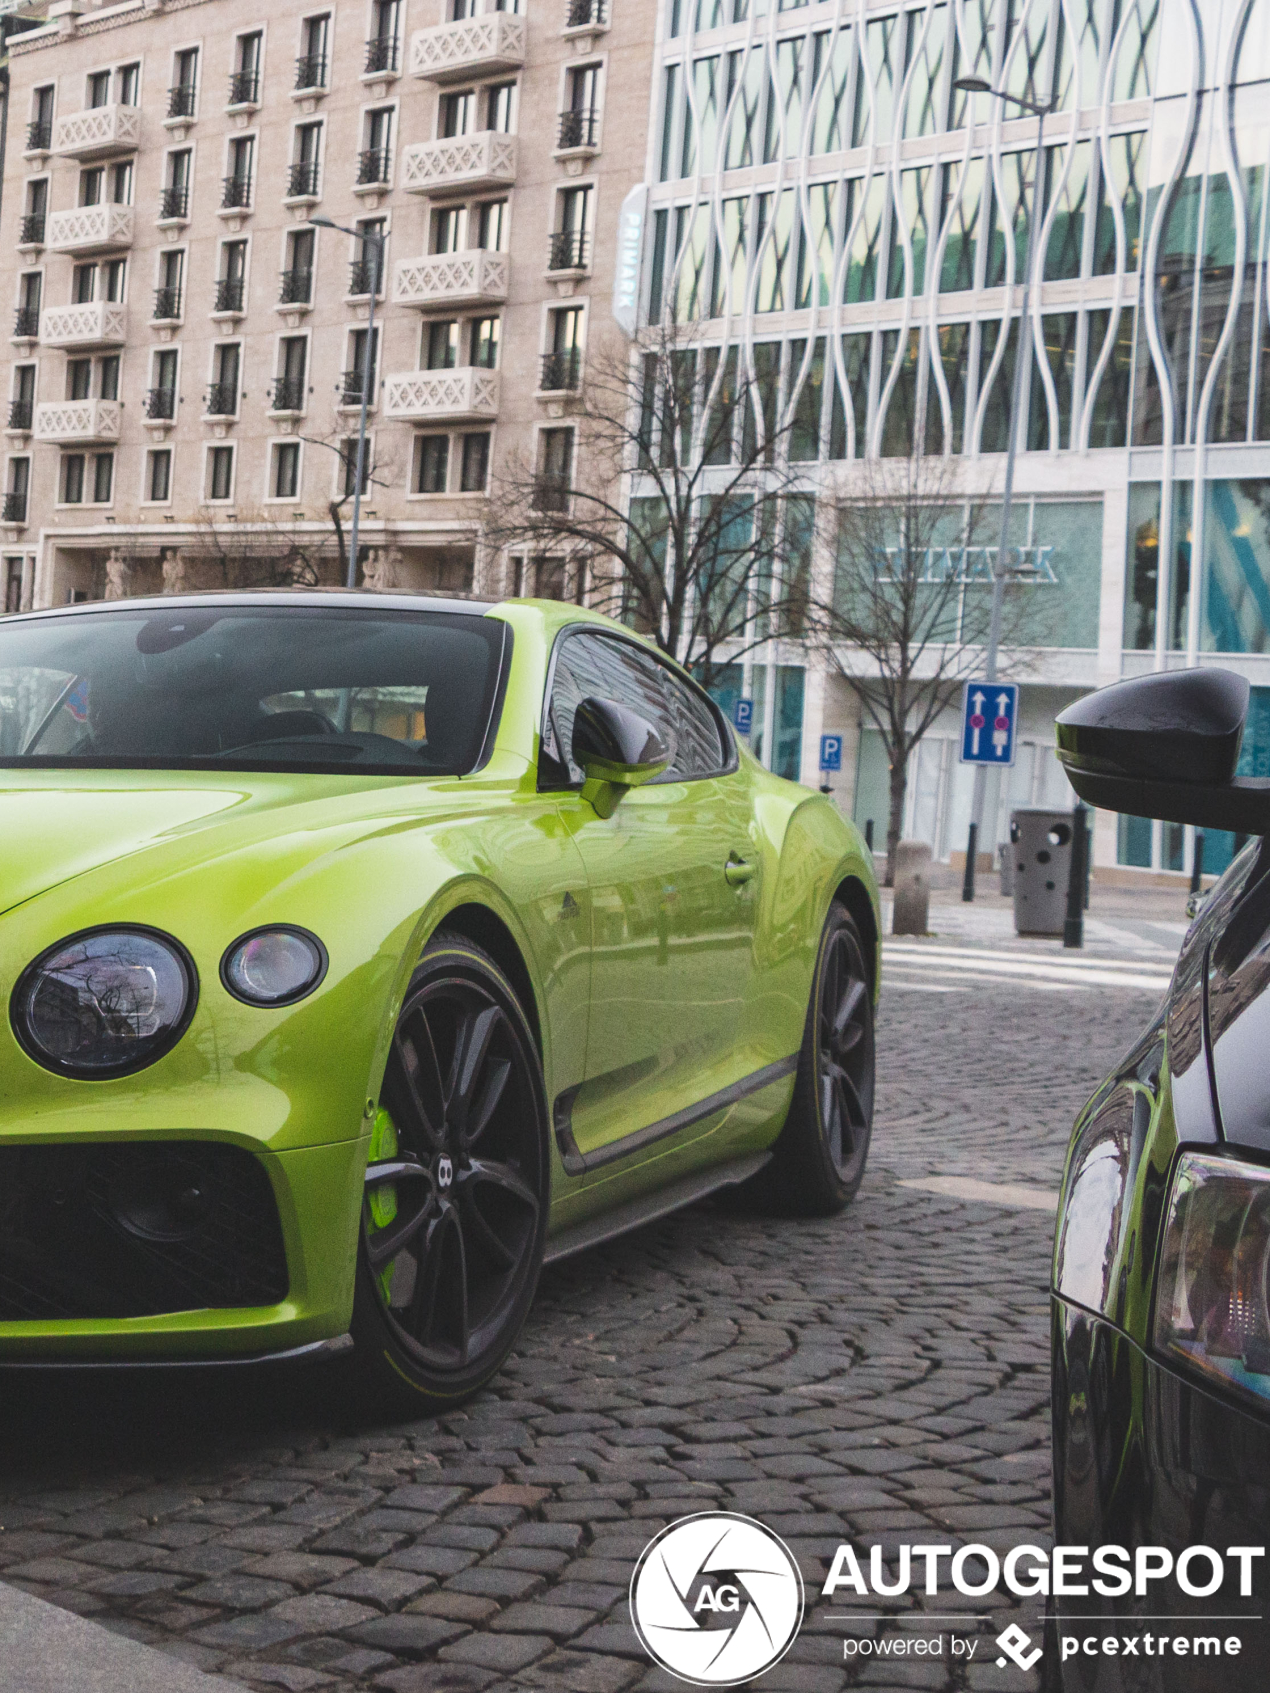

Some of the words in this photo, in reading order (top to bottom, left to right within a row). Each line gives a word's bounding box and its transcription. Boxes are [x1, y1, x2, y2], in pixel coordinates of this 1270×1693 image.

[619, 213, 642, 308] PRIMARK
[738, 703, 750, 723] P
[825, 739, 839, 760] P
